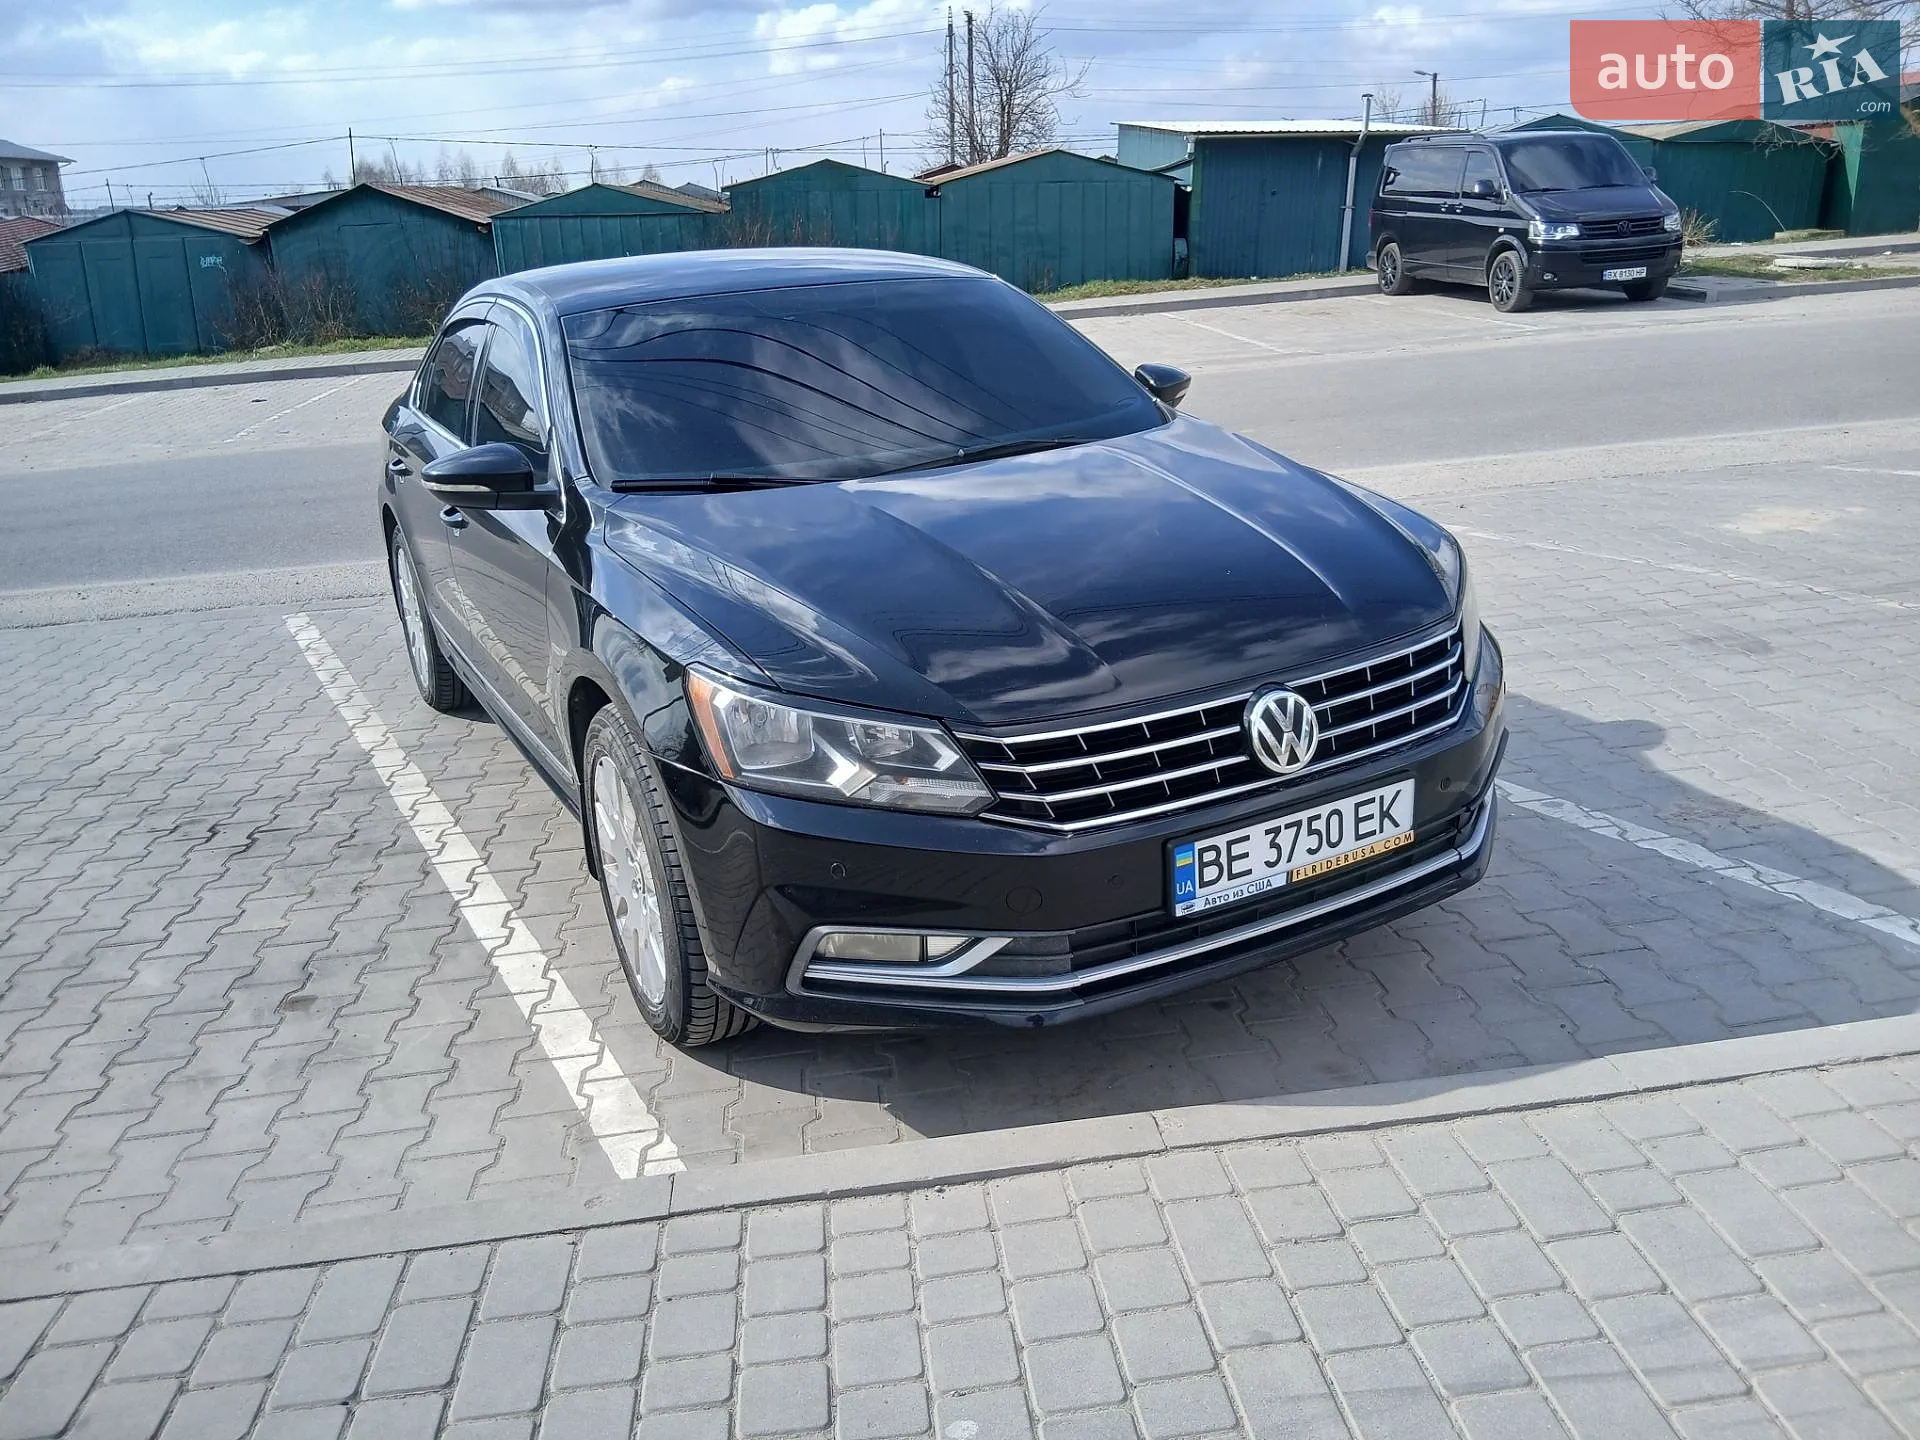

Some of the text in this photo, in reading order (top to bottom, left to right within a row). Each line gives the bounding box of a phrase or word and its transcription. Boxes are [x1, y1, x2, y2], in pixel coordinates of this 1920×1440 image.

[1197, 789, 1402, 889] BE 3750 EK
[1296, 832, 1412, 879] FLRIDERUSA.COM
[1176, 880, 1194, 895] UA
[1246, 879, 1273, 895] США
